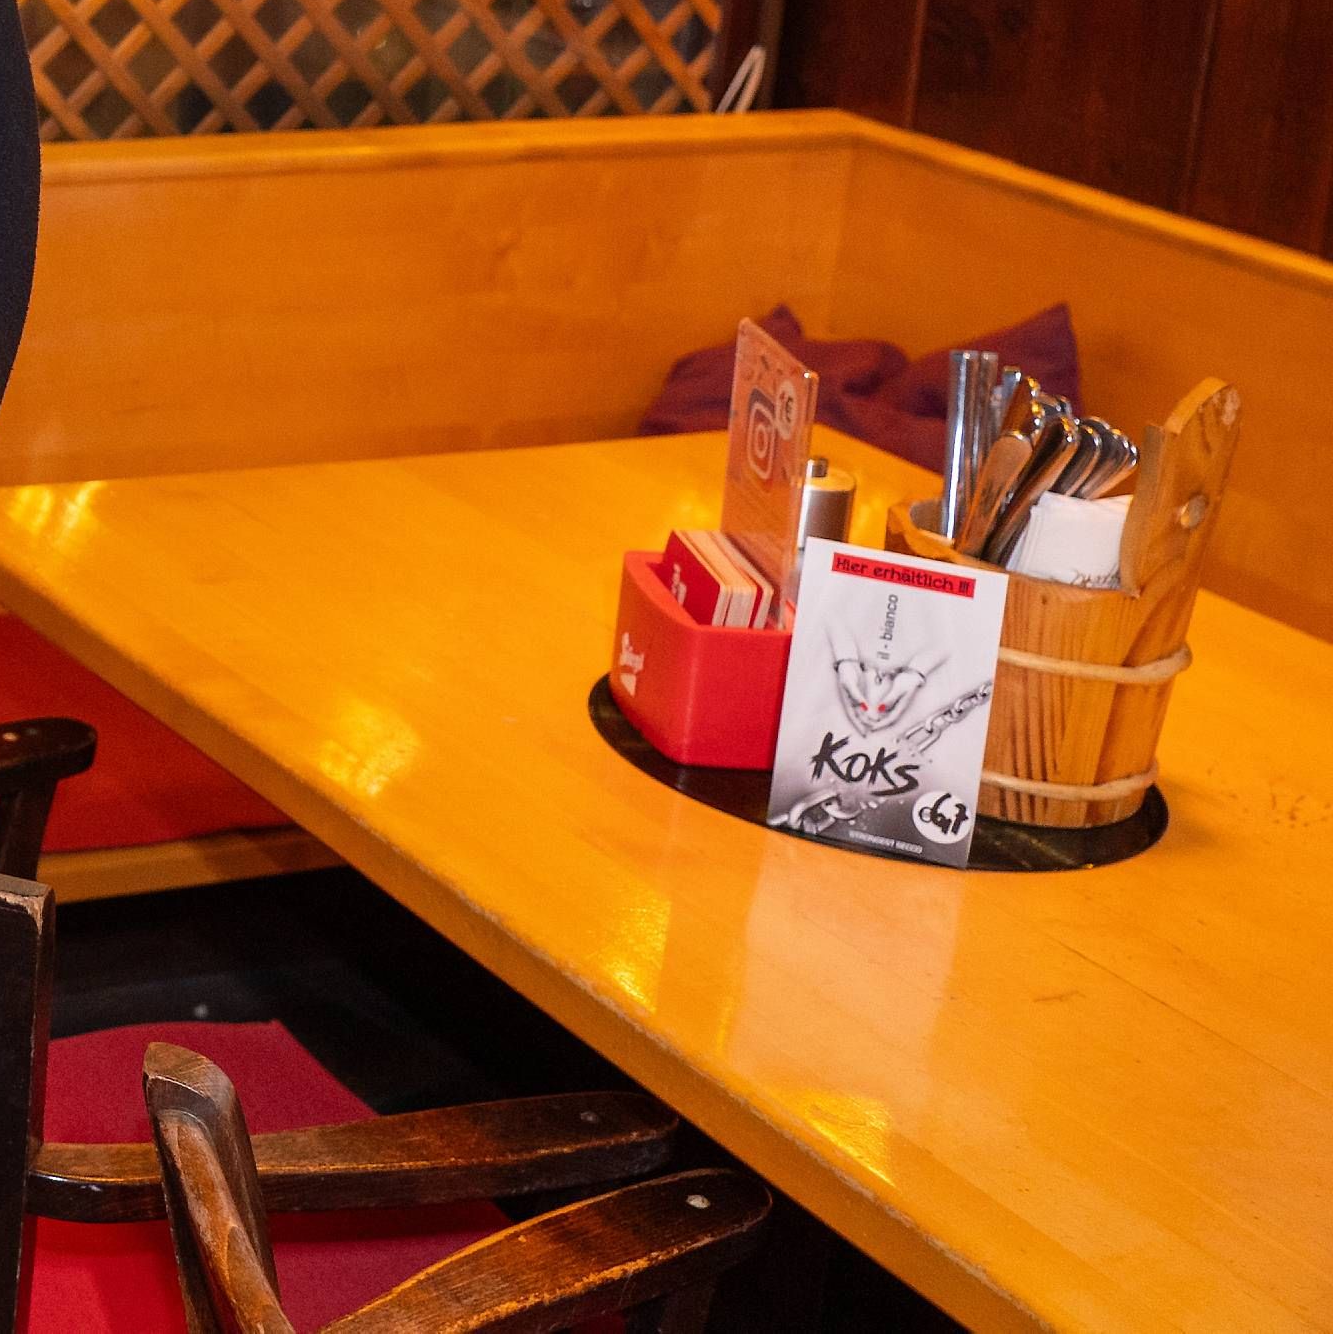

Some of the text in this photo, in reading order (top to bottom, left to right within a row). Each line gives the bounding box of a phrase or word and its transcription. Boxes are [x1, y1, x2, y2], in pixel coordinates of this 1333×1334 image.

[836, 557, 869, 575] Hier
[873, 566, 954, 592] erhältlich
[879, 594, 899, 641] bianco
[810, 731, 921, 796] KOKS
